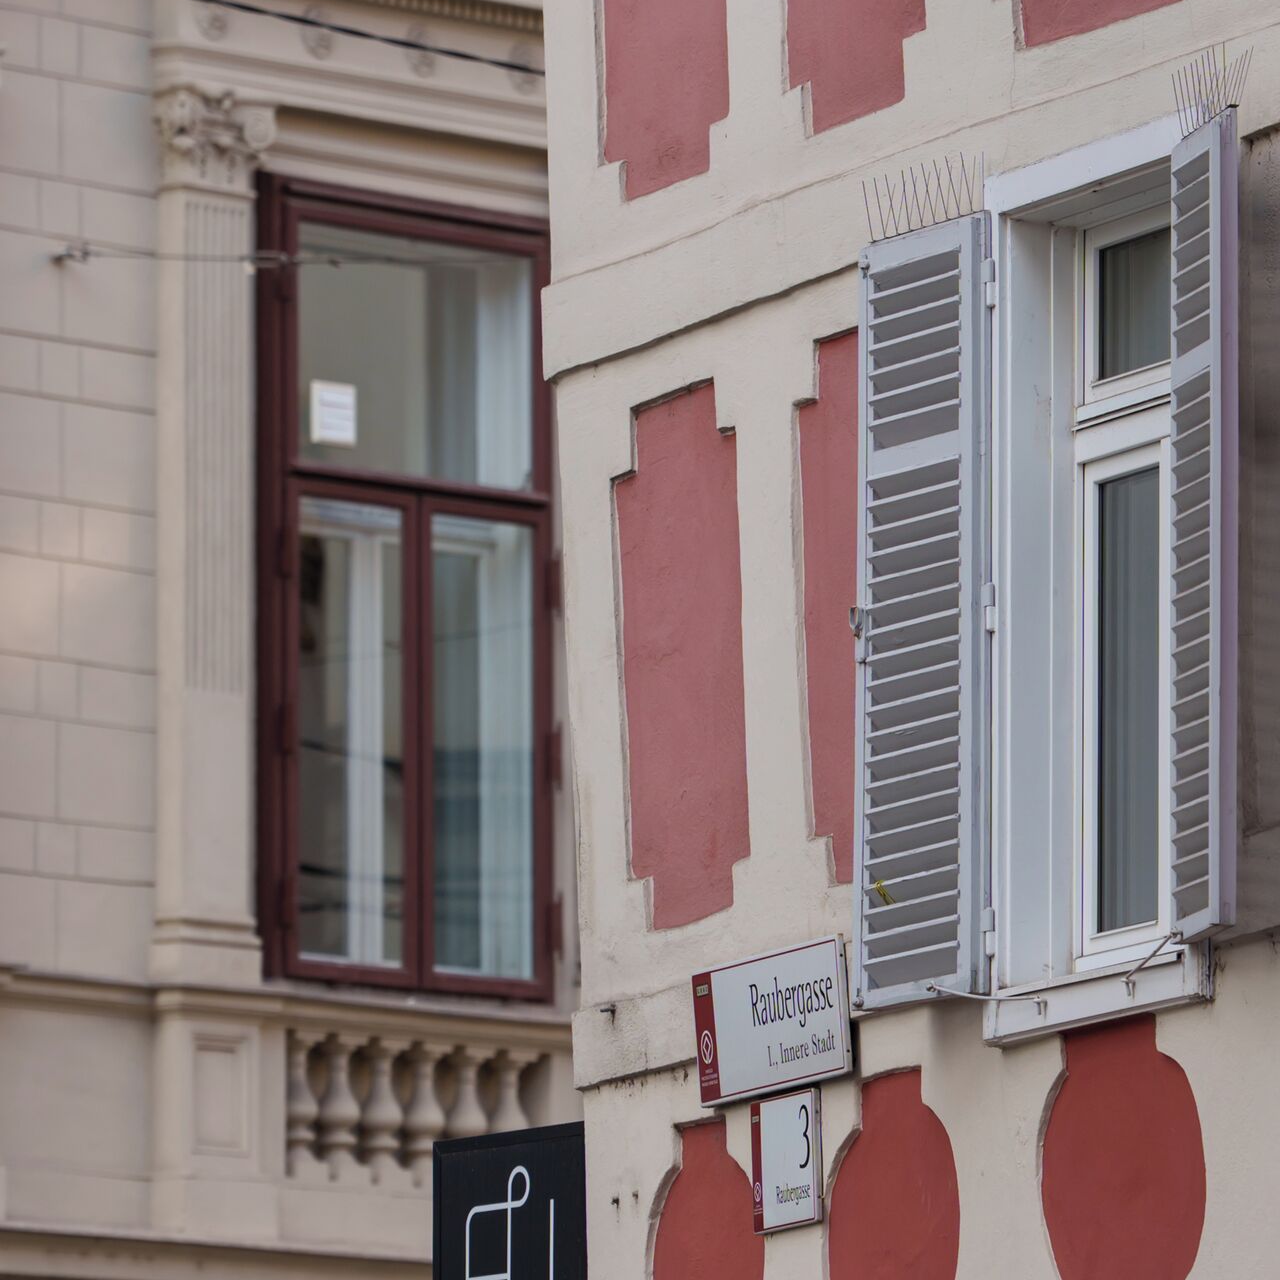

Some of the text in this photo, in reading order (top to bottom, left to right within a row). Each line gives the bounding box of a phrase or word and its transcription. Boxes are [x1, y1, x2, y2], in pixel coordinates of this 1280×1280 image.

[748, 976, 834, 1028] Raubergasse
[779, 1042, 810, 1065] Innere
[811, 1028, 836, 1056] Stadt
[798, 1104, 811, 1170] 3
[776, 1183, 811, 1206] Raubergasse
